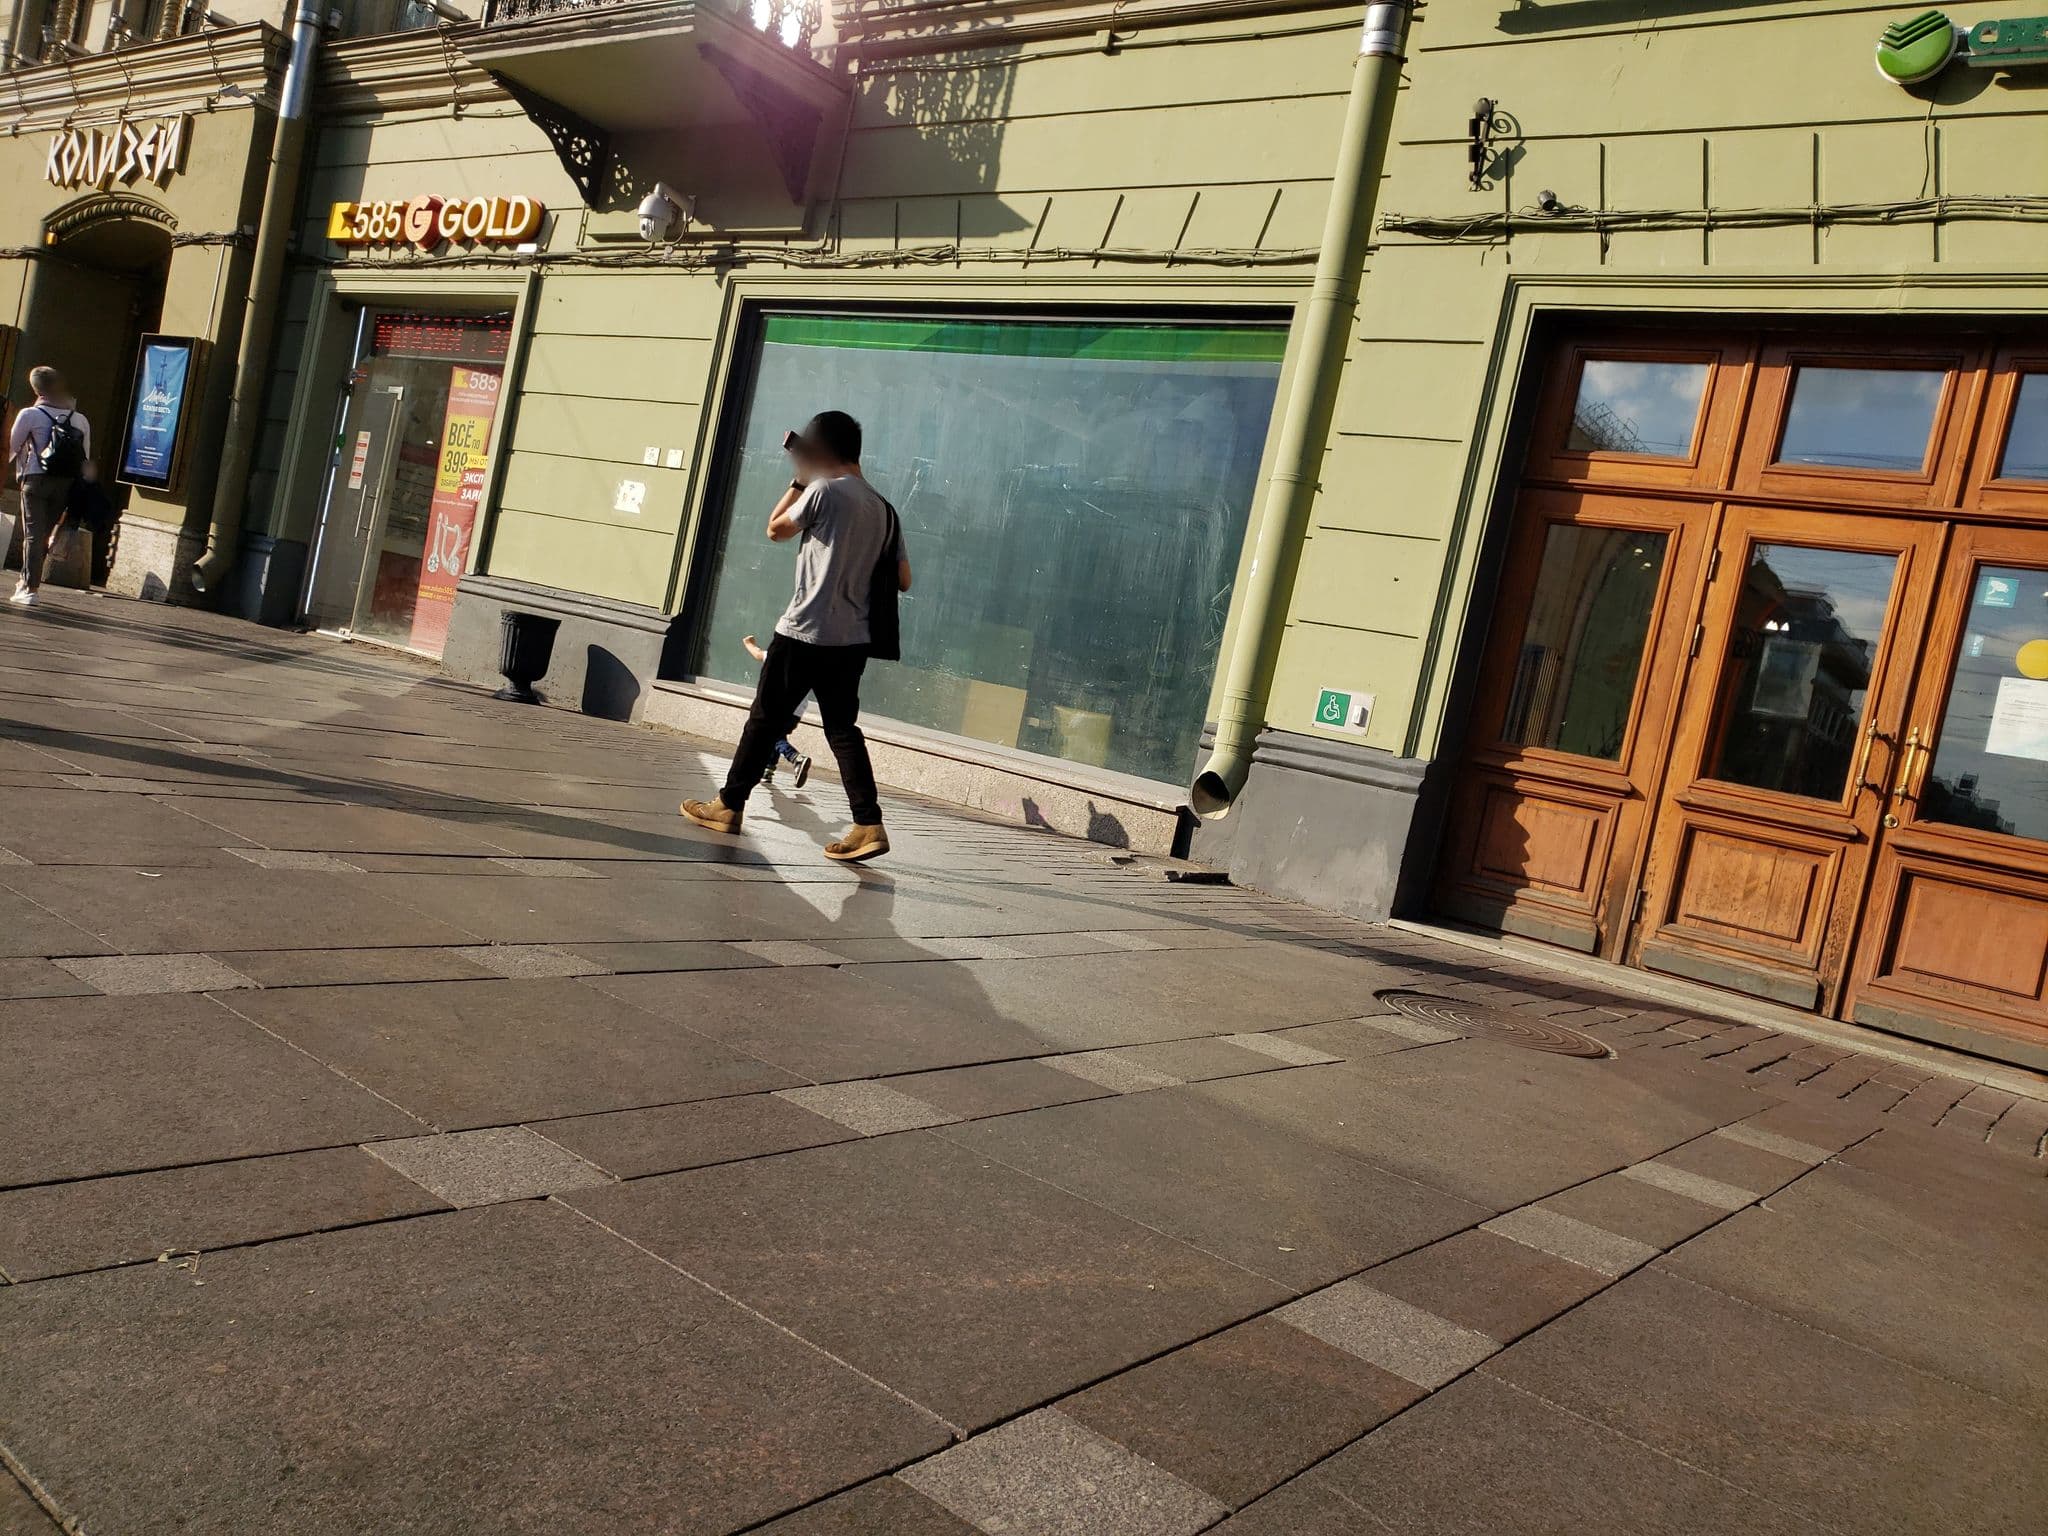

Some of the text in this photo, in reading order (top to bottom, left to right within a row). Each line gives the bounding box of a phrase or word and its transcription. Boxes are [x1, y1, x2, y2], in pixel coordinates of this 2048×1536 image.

[352, 200, 404, 239] 585
[438, 195, 532, 238] GOLD
[469, 371, 498, 392] 585
[448, 421, 475, 448] ВСЁ
